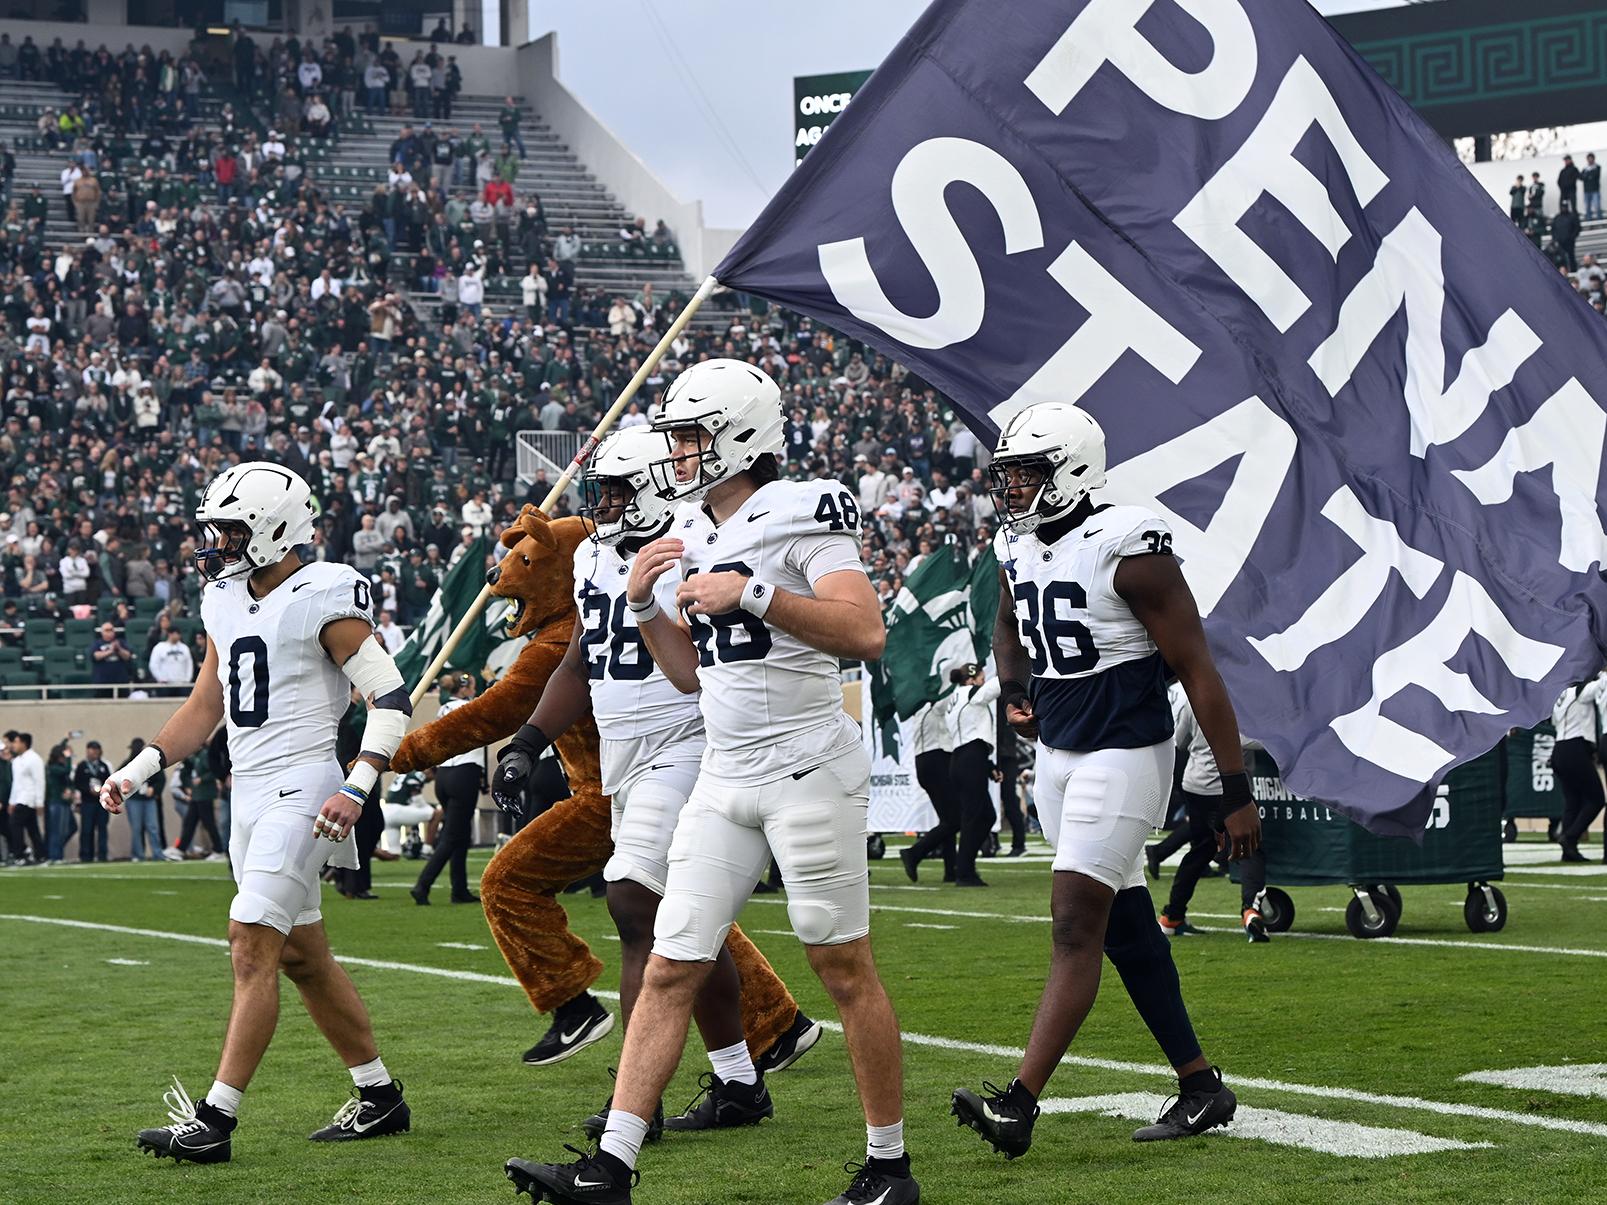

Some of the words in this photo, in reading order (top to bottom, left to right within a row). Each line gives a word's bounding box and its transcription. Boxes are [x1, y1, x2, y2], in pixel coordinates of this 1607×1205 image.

[818, 137, 1566, 784] STATE
[813, 491, 859, 532] 48
[1140, 530, 1173, 554] 36
[354, 579, 370, 611] 0
[579, 591, 655, 680] 28
[1013, 580, 1100, 675] 36
[228, 635, 270, 728] 0
[968, 664, 977, 676] S
[1258, 806, 1332, 821] OTBALL
